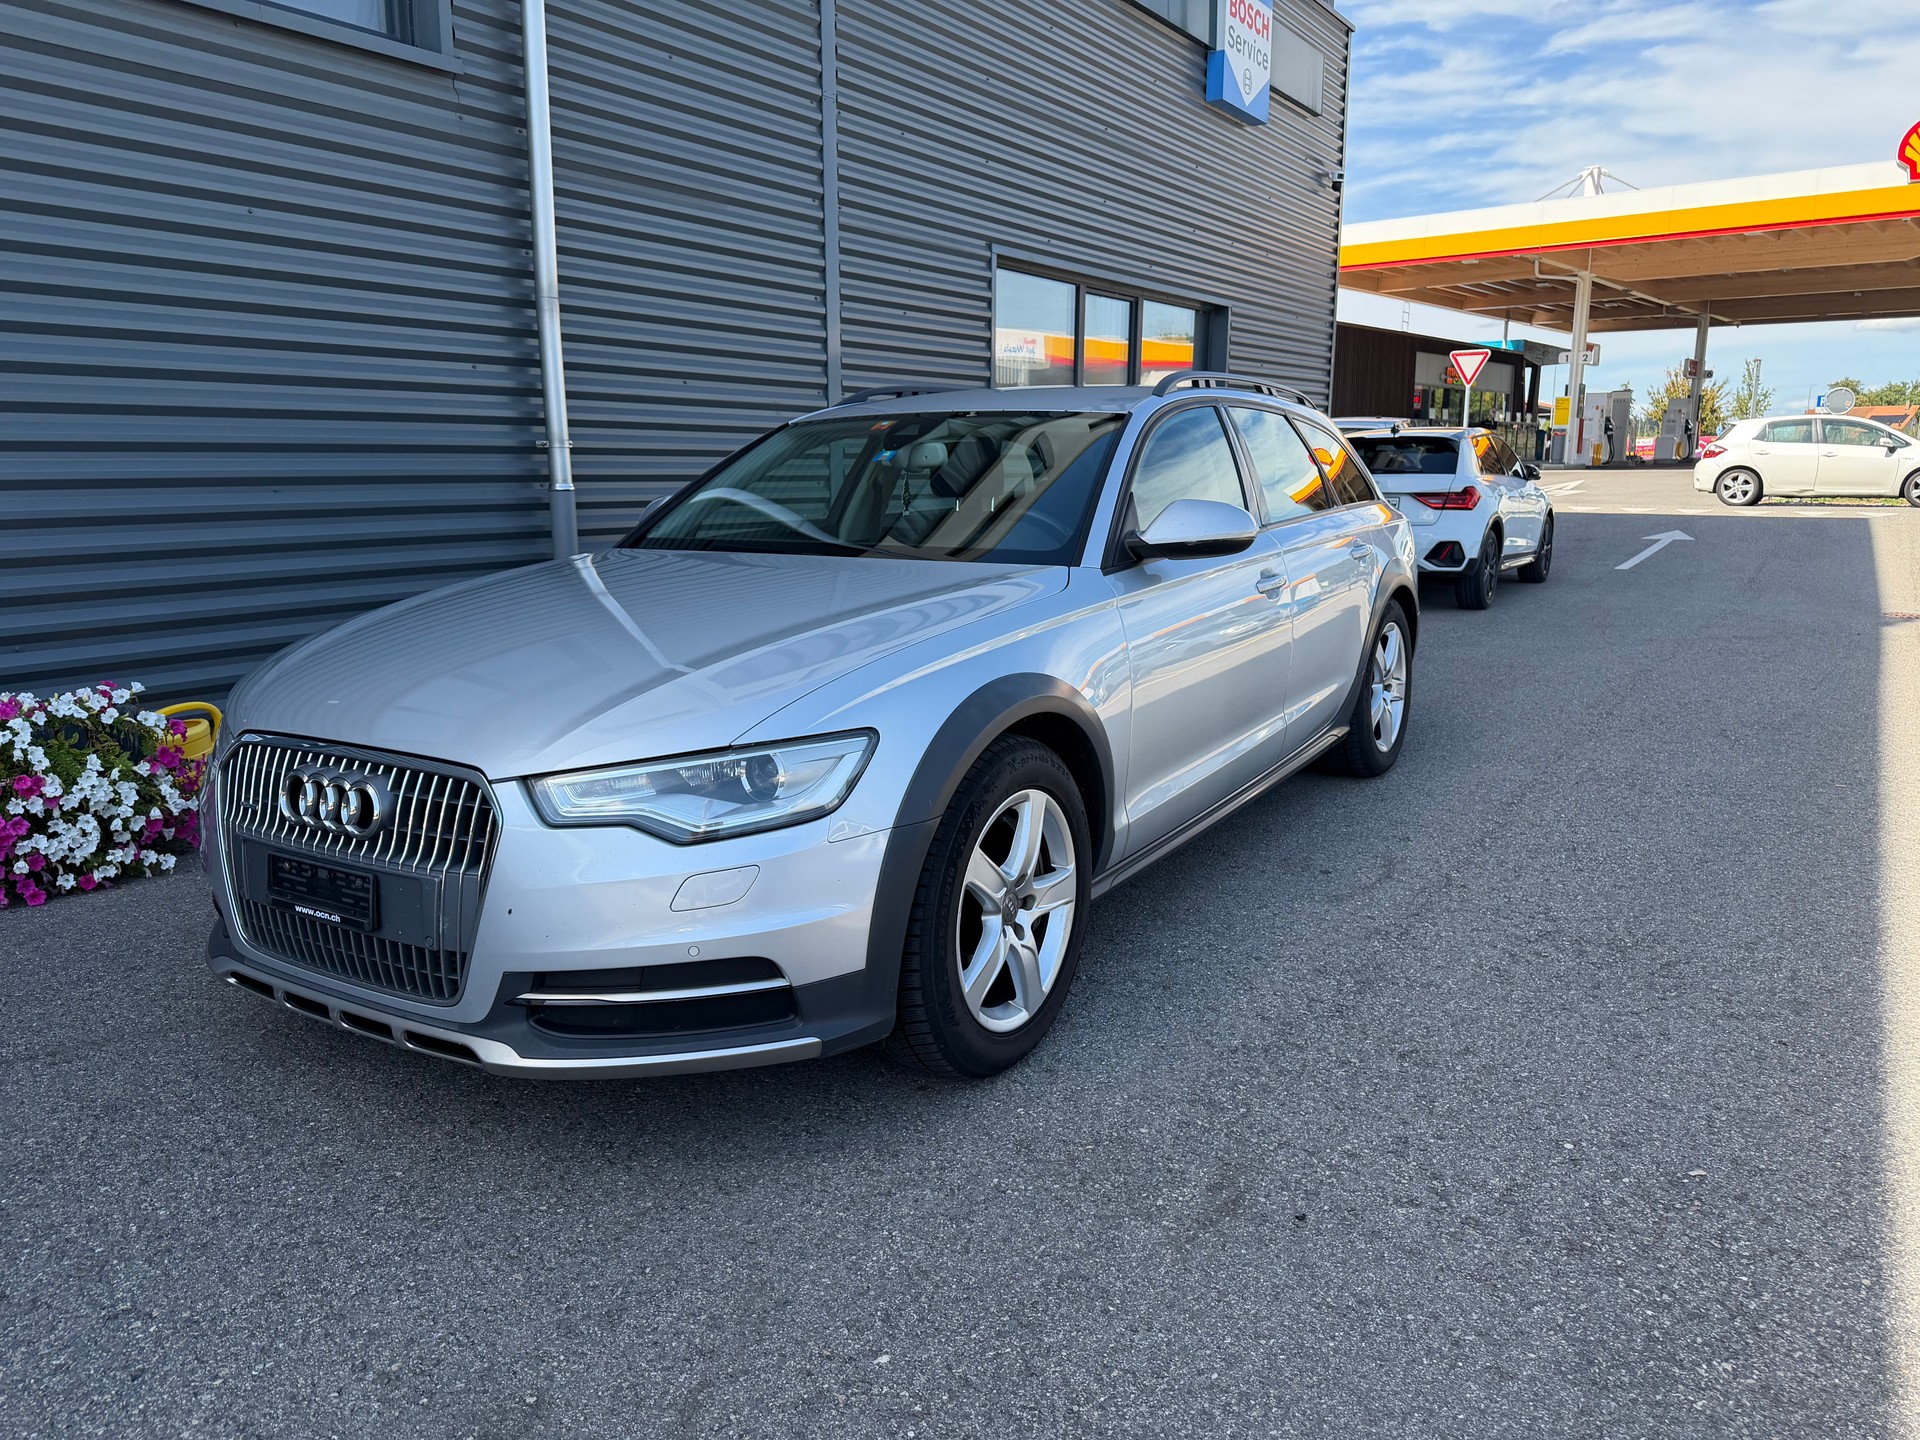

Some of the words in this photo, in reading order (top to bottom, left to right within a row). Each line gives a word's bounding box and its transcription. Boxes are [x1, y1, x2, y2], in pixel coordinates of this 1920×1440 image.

[1229, 0, 1270, 42] BOSCH
[1228, 25, 1269, 71] Service
[1582, 353, 1589, 362] 2
[294, 904, 341, 923] www.ocn.ch
